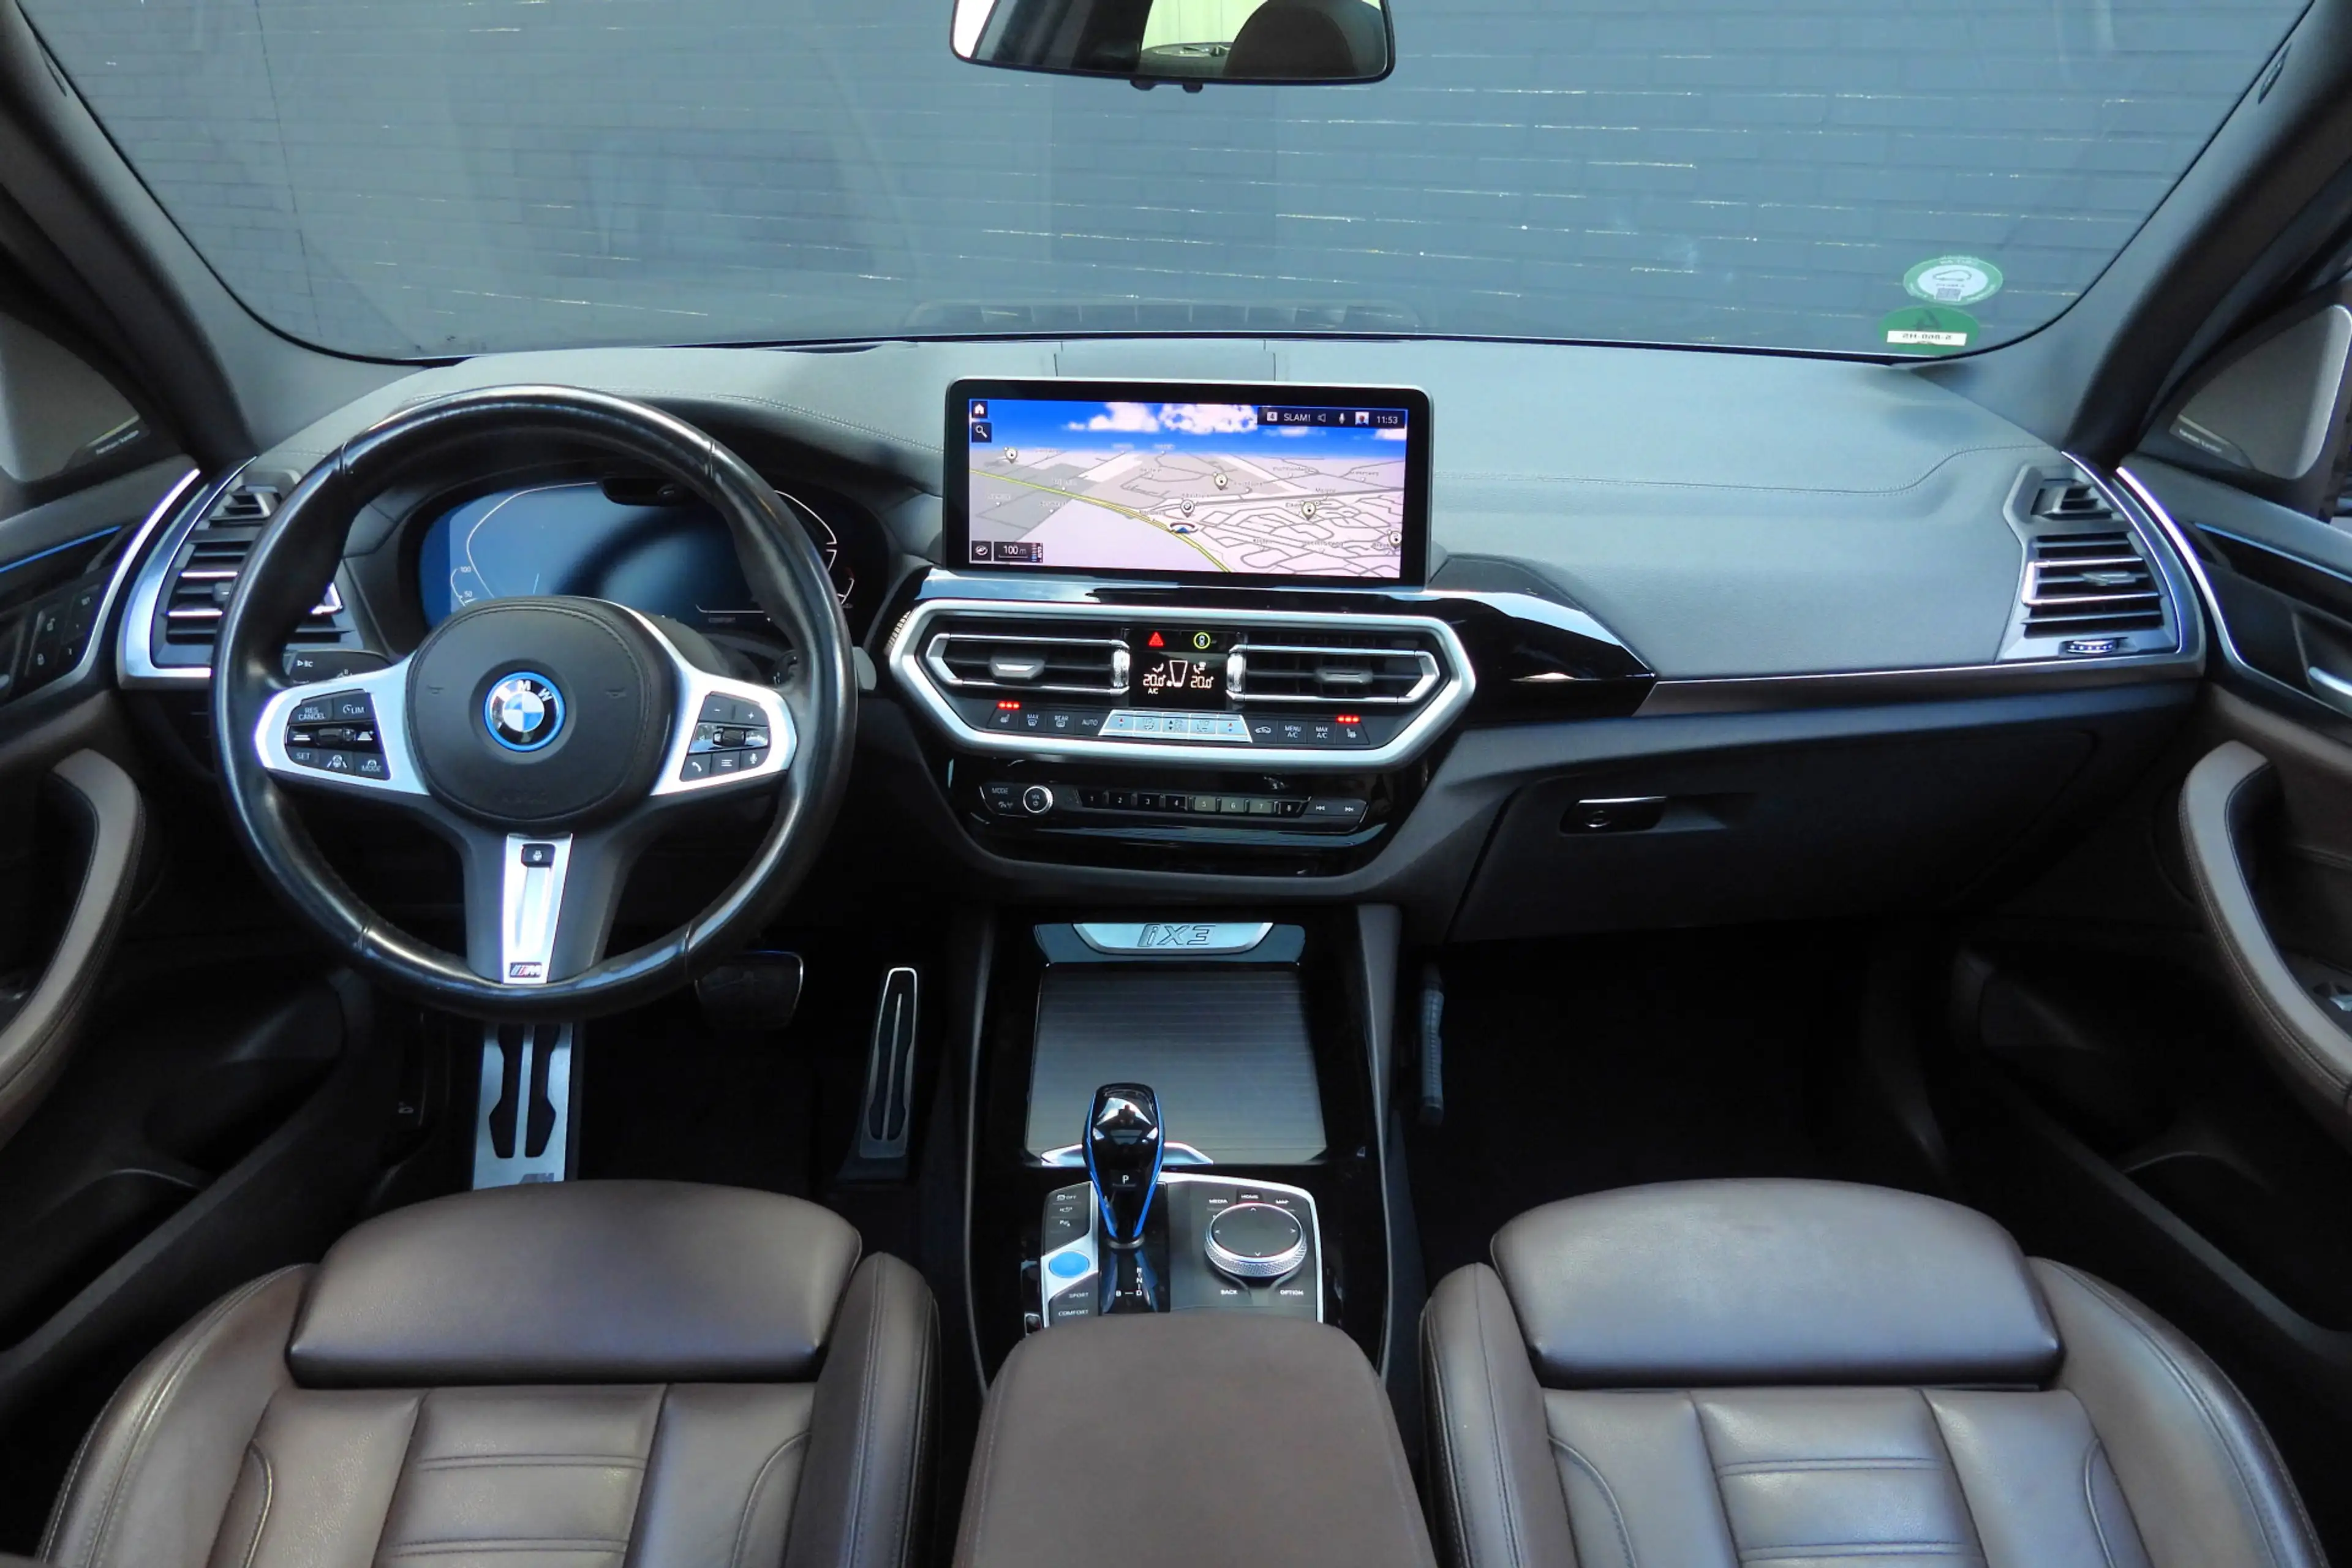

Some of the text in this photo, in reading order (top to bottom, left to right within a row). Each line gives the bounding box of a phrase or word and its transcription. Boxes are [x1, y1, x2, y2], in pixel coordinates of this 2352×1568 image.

[1284, 413, 1311, 422] SLAM!
[1377, 416, 1398, 424] 11:53
[1003, 545, 1019, 554] 100
[1137, 923, 1216, 947] iX3
[1122, 1174, 1129, 1184] P
